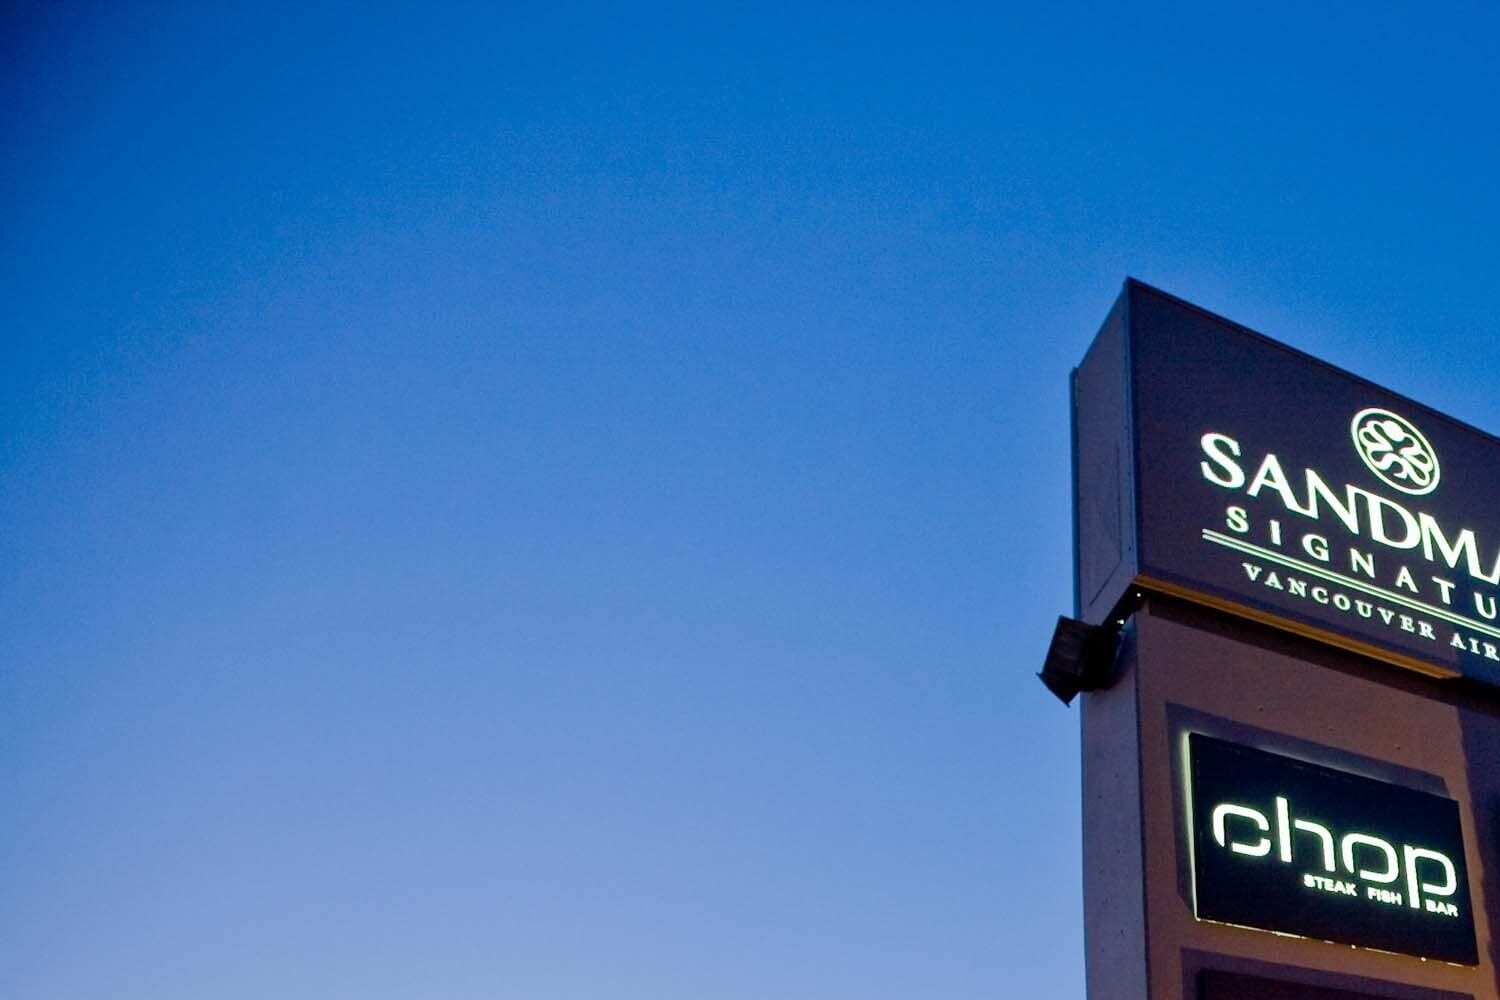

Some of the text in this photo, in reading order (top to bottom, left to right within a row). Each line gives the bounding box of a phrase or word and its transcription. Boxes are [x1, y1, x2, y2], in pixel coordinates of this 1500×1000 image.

[1241, 562, 1437, 641] VANCOUVER
[1212, 796, 1458, 909] chop
[1303, 873, 1459, 918] STEAK FISH BAR
